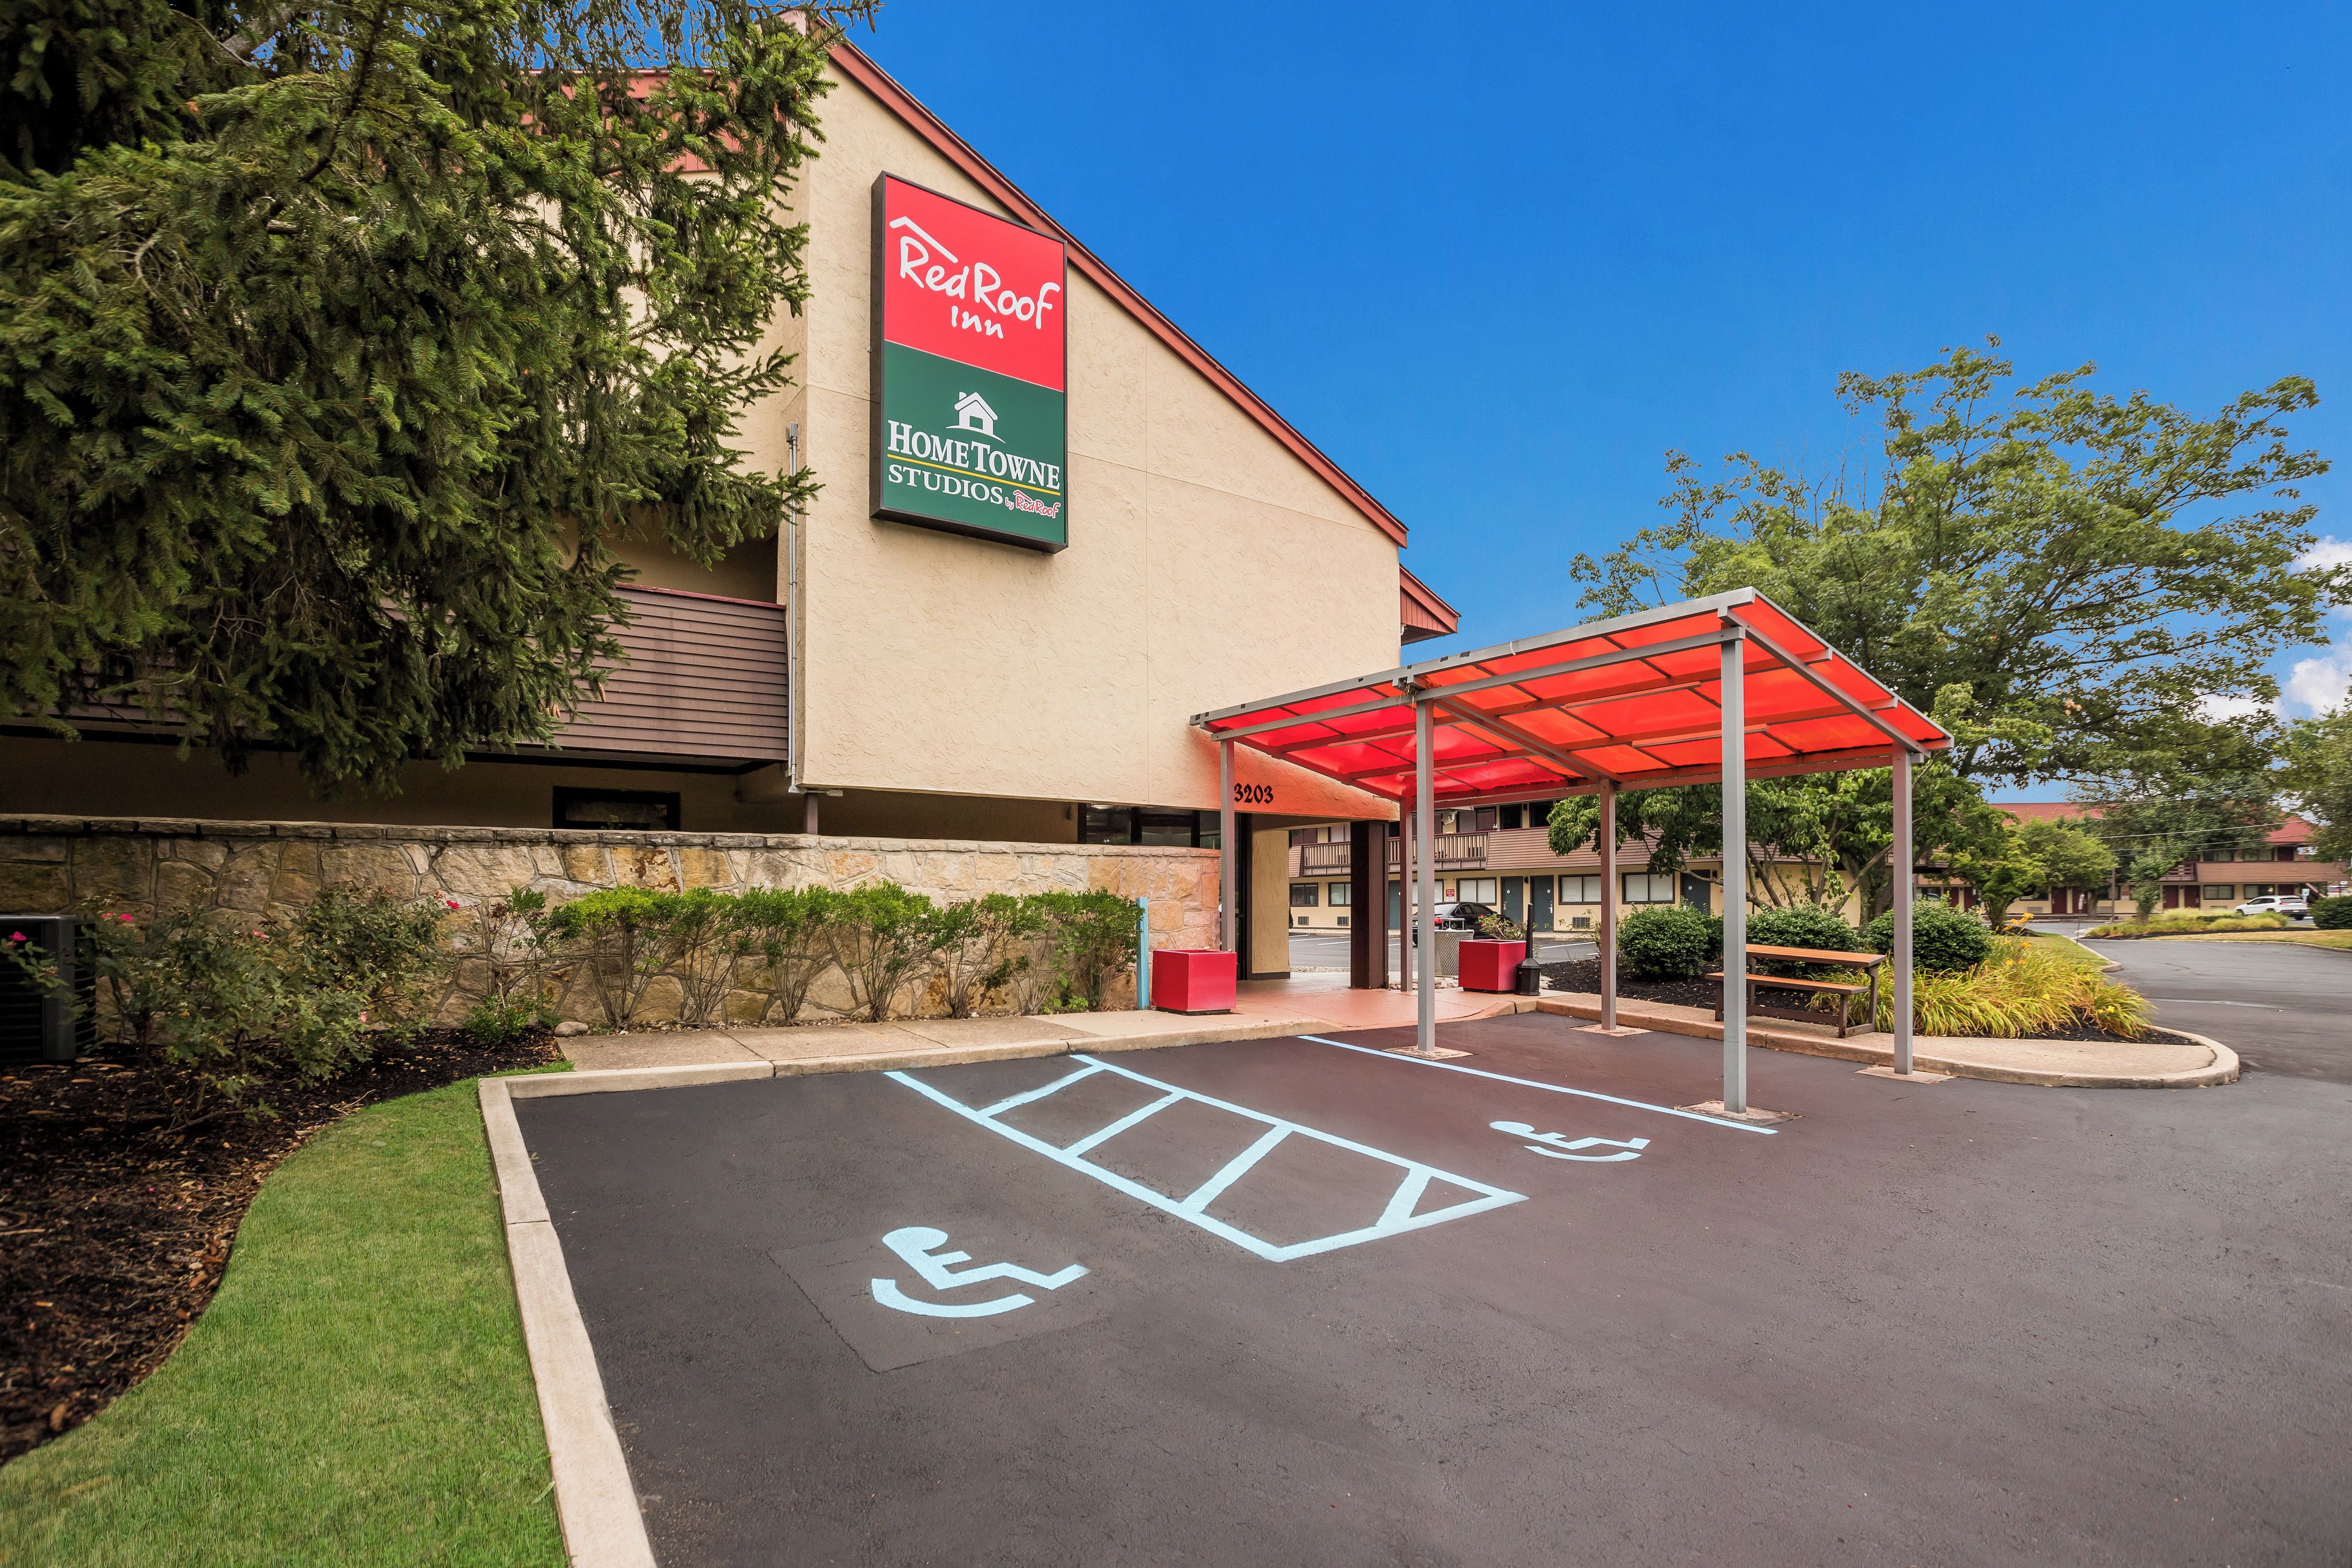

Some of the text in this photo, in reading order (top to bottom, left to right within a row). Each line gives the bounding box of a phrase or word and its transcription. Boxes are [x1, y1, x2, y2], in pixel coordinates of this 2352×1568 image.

[888, 464, 1003, 505] STUDIOS
[1005, 497, 1014, 510] by
[1234, 783, 1274, 804] 3203
